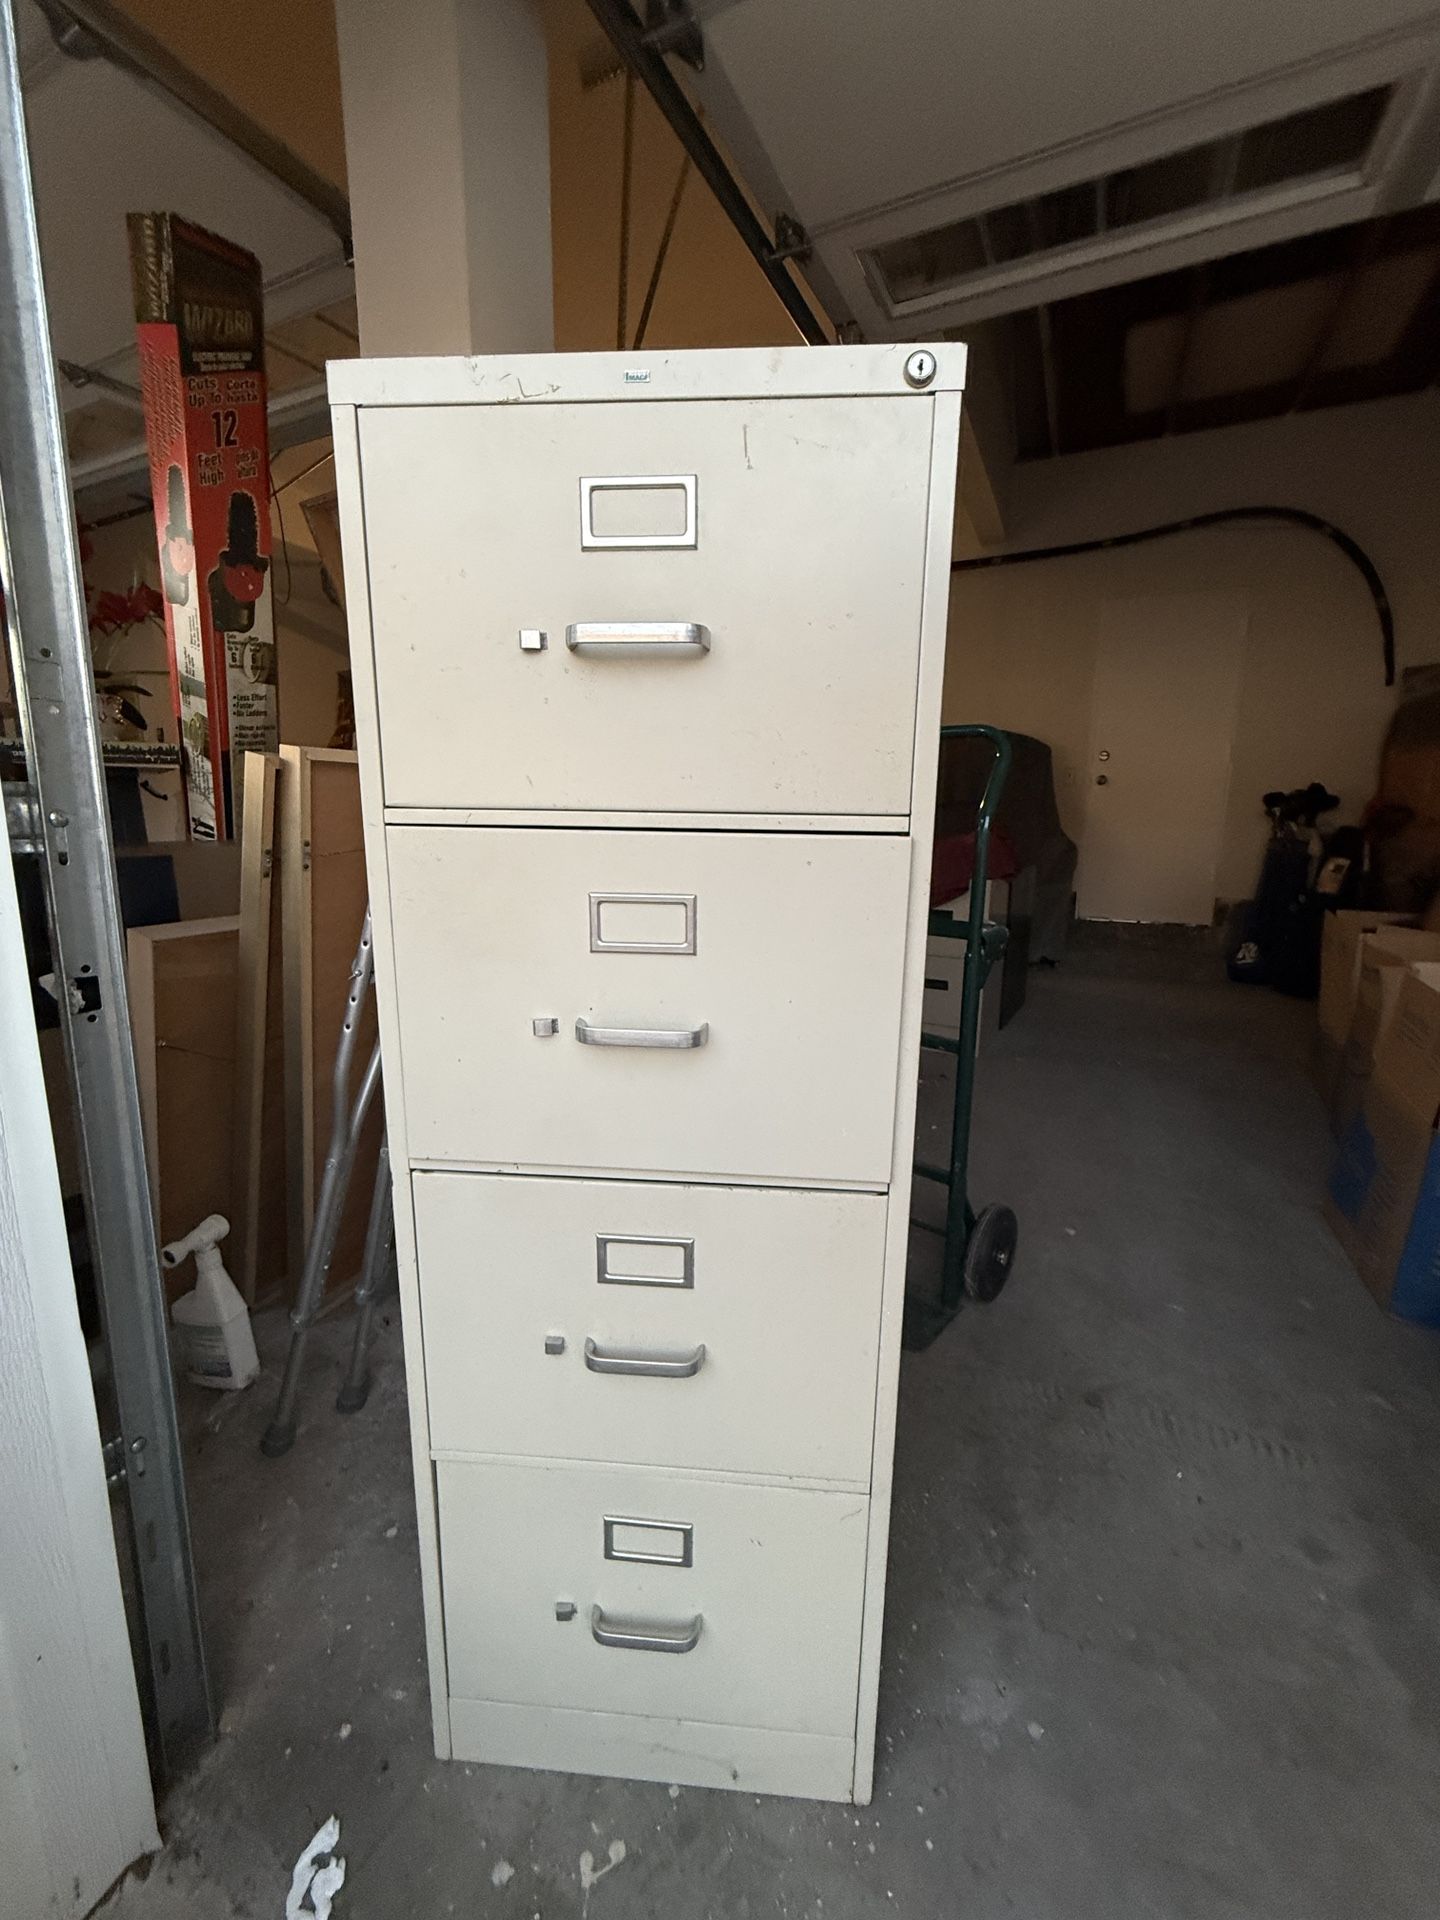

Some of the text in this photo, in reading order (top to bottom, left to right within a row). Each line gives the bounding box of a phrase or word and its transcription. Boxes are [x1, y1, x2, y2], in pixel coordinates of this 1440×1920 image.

[188, 376, 217, 391] Cuts
[188, 394, 206, 408] Up
[211, 408, 240, 449] 12
[197, 452, 222, 467] Feet
[199, 468, 224, 485] High
[231, 652, 237, 663] 6
